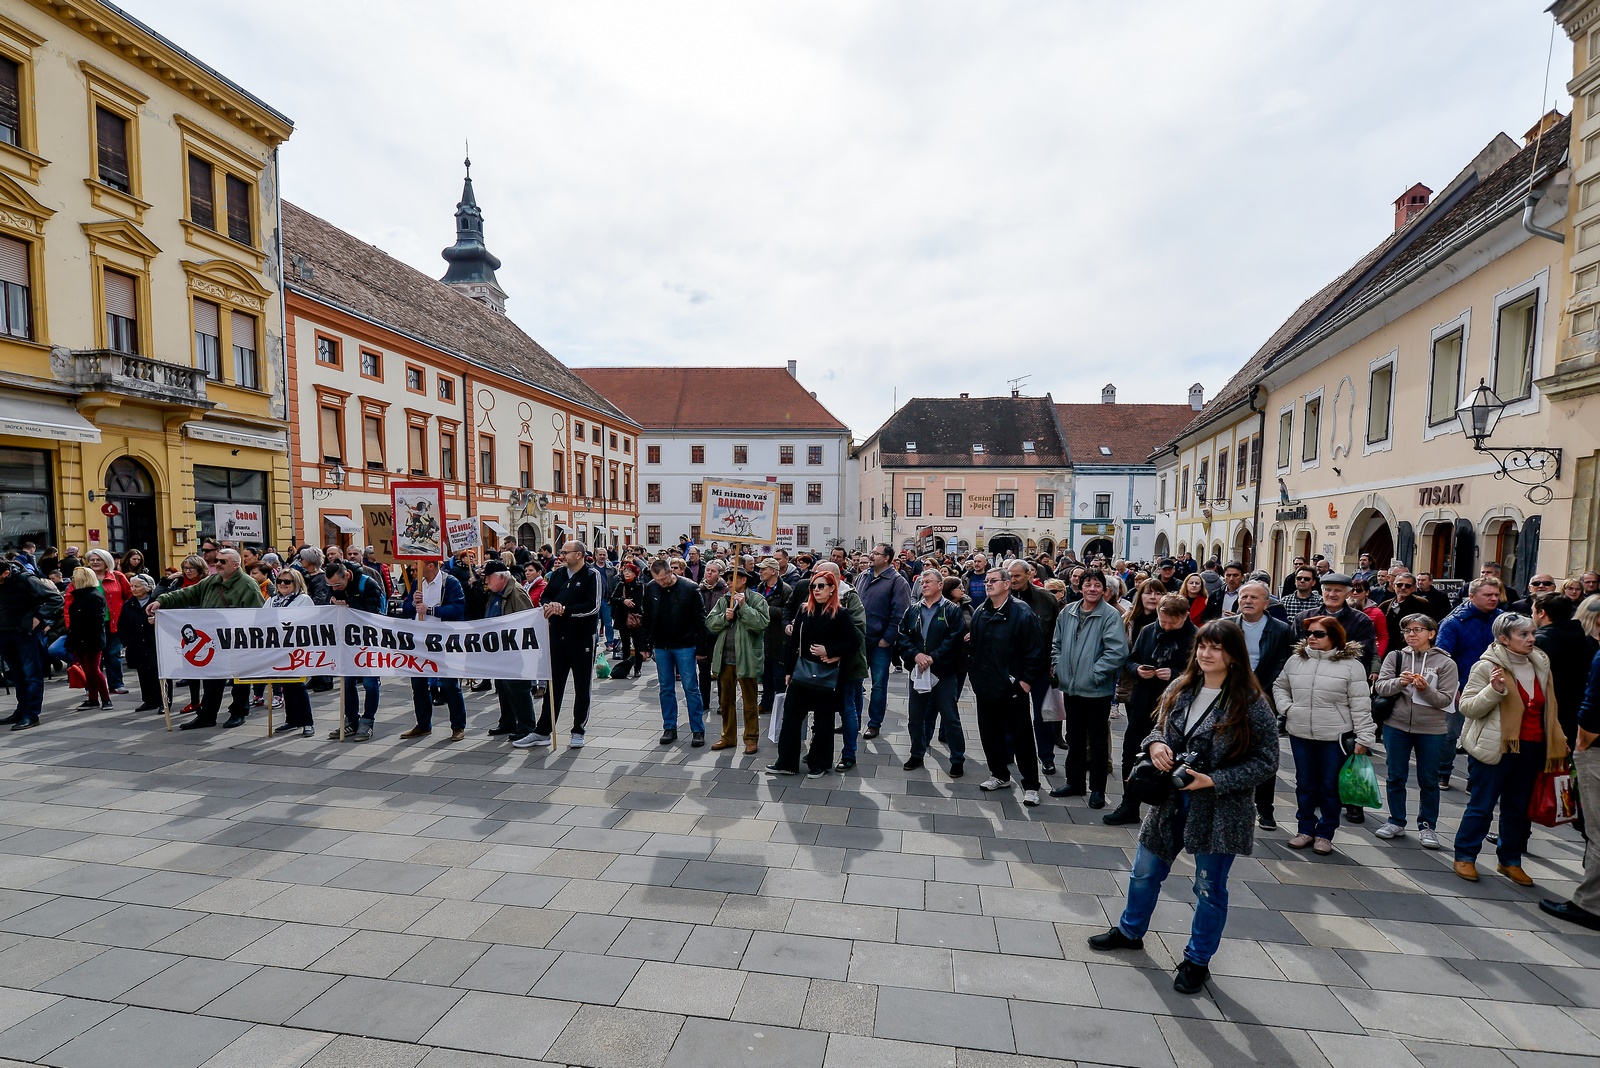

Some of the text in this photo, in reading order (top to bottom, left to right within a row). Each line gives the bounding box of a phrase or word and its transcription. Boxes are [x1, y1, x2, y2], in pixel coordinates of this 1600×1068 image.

[711, 488, 722, 496] Mi
[724, 490, 751, 499] nismo
[718, 497, 765, 511] BANKOMAT
[1419, 483, 1464, 506] TISAK
[216, 621, 540, 653] VARAŽDIN GRAD BAROKA
[272, 646, 439, 673] BEZ ČEHOKA
